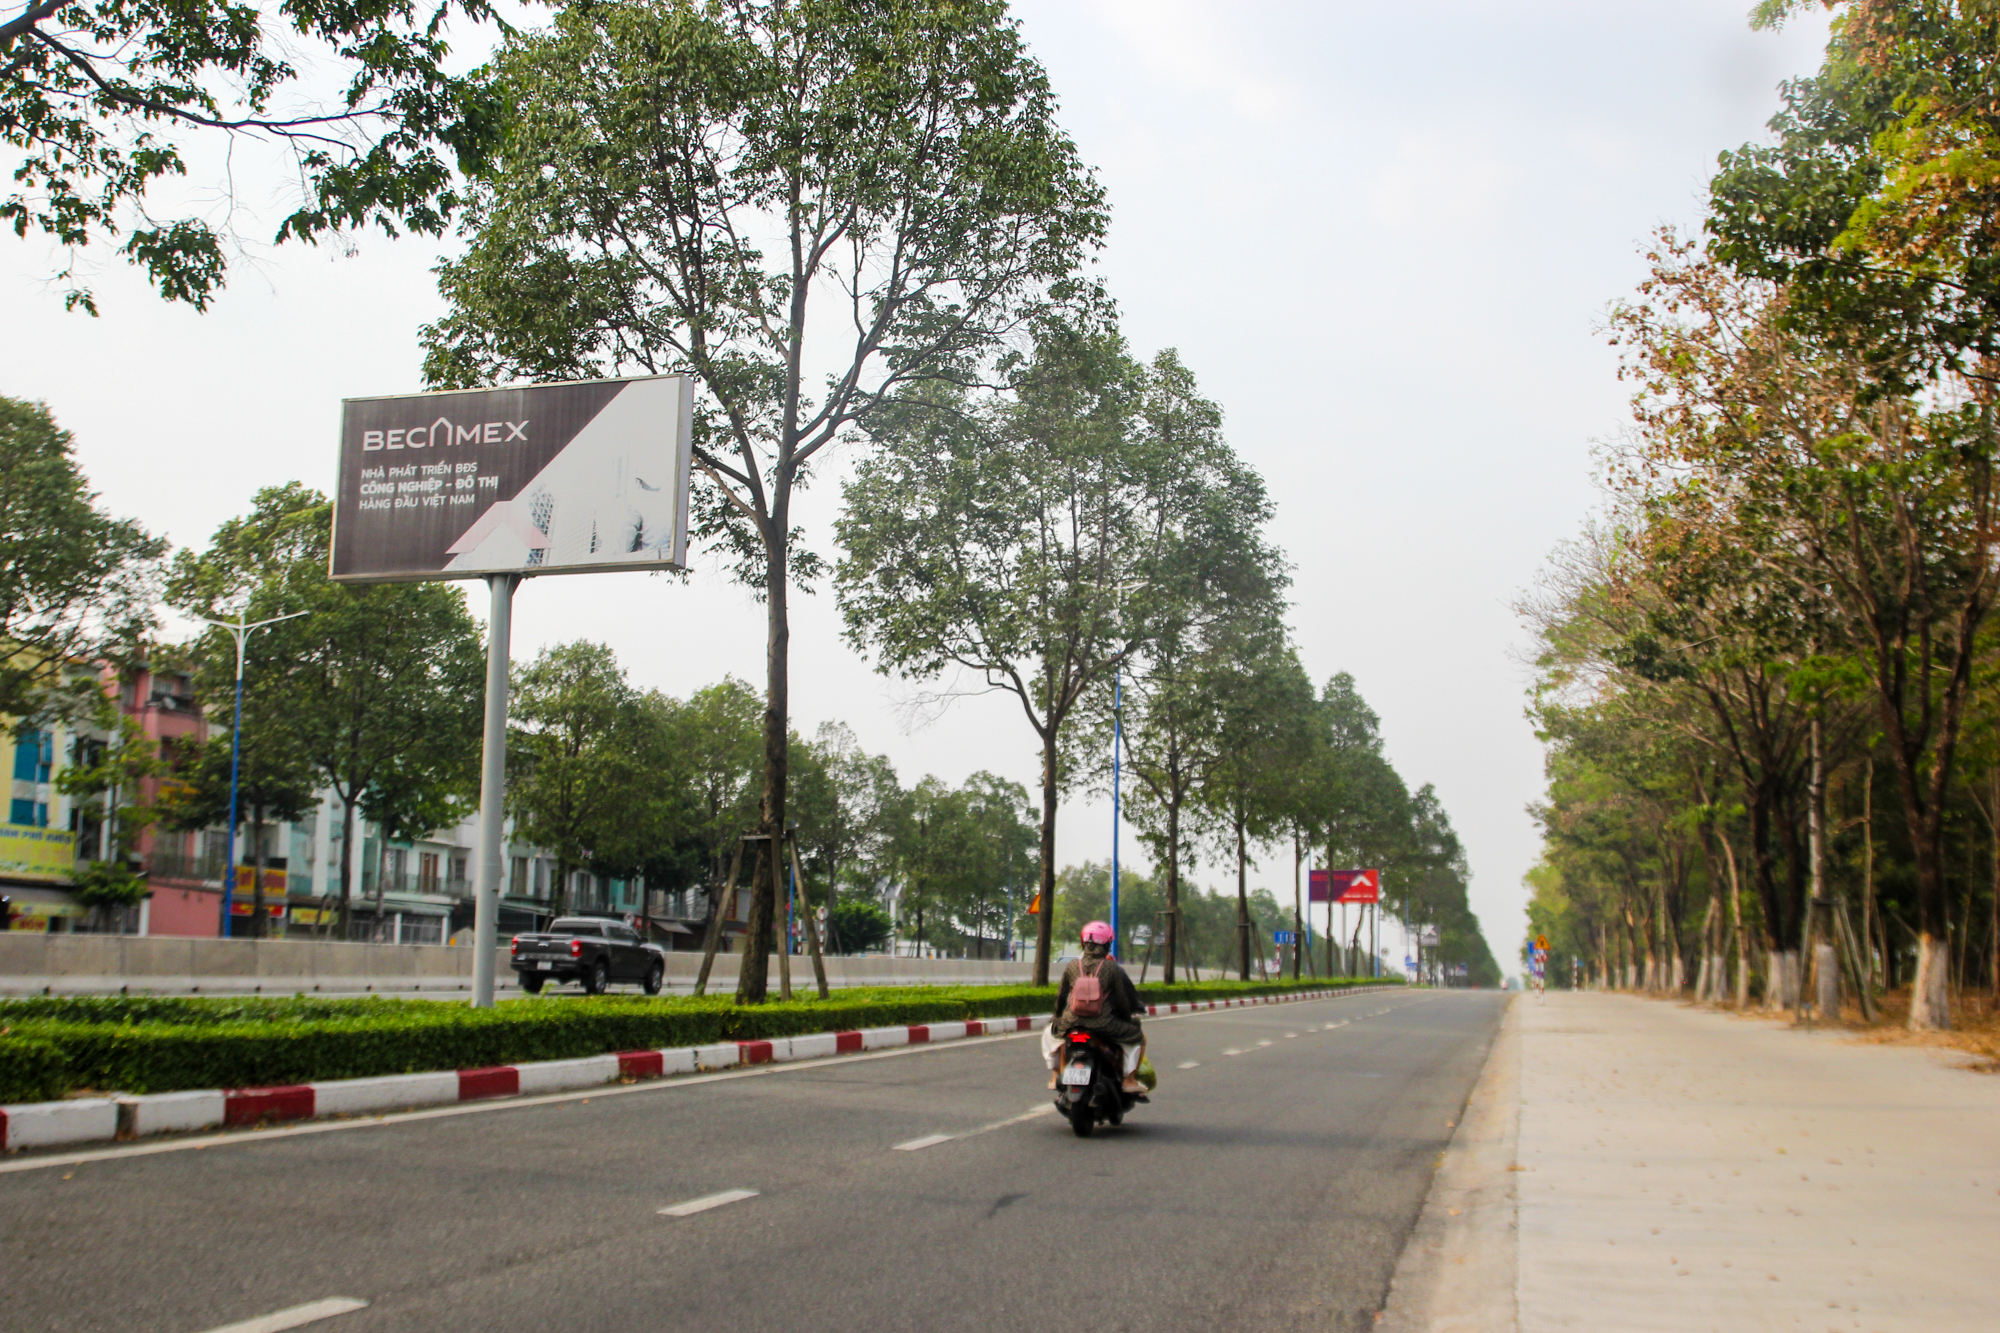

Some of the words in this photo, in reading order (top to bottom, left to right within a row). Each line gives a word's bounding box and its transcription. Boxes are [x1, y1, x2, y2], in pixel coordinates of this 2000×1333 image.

[363, 416, 530, 452] BECAMEX
[361, 465, 385, 479] NHÀ
[388, 463, 418, 478] PHÁT
[420, 460, 452, 476] TRIỂN
[455, 462, 478, 474] BĐS
[360, 480, 395, 494] CÔNG
[397, 477, 443, 493] NGHIỆP
[455, 474, 475, 489] ĐÔ
[478, 475, 499, 490] THỊ
[359, 497, 391, 510] HÀNG
[394, 494, 419, 508] ĐẦU
[422, 493, 447, 508] VIỆT
[449, 494, 476, 505] NAM
